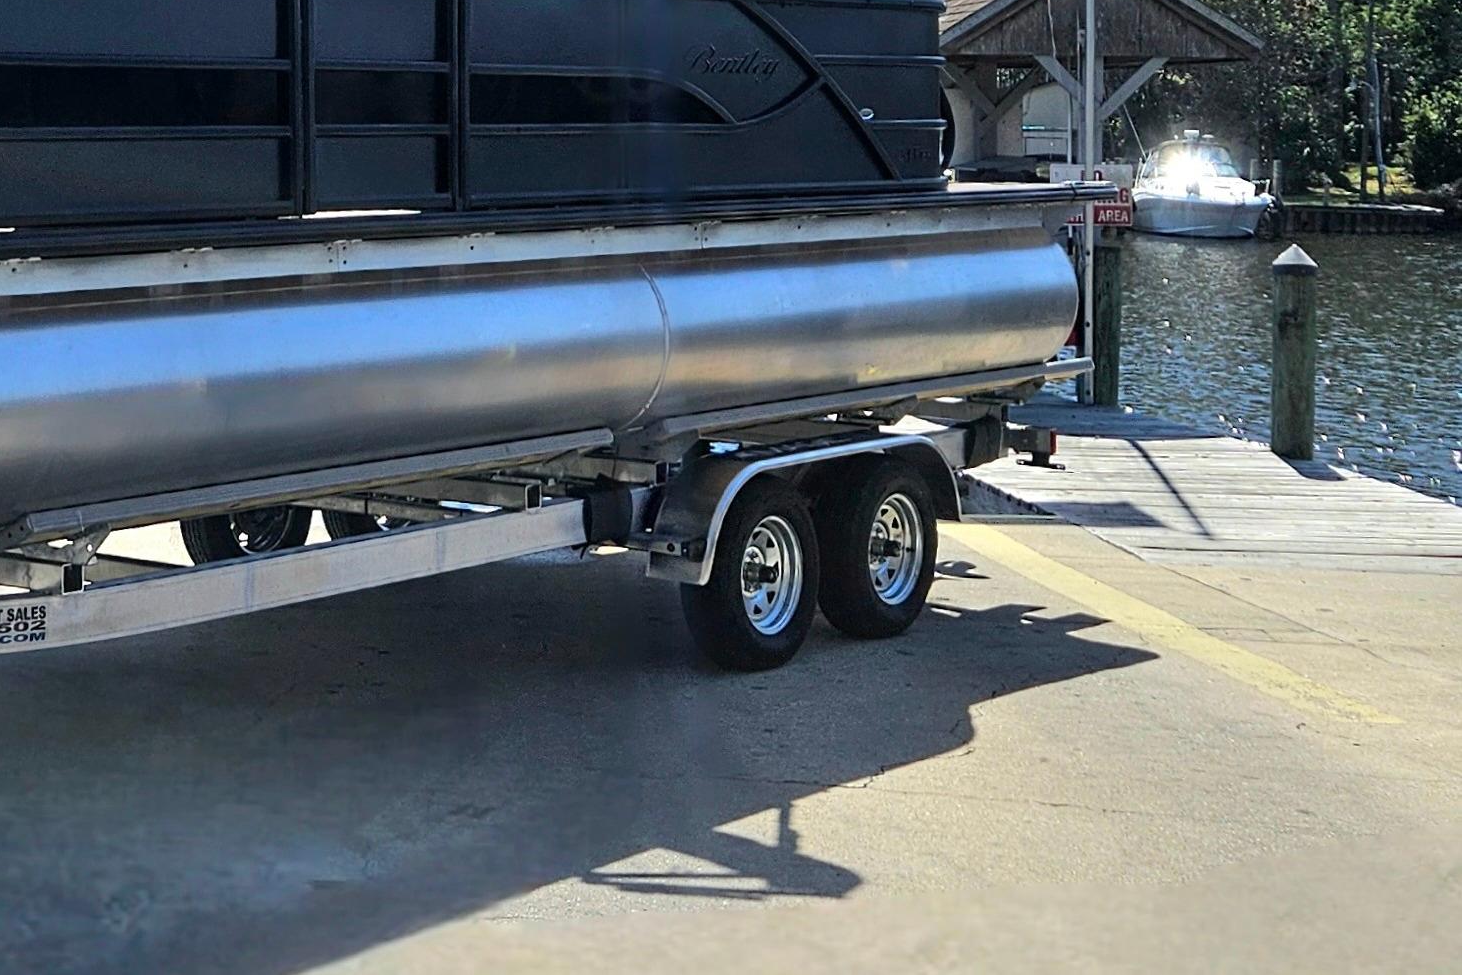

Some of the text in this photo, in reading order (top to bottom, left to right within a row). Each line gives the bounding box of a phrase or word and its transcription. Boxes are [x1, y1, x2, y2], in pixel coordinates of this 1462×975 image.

[683, 42, 779, 83] Bentley
[1098, 209, 1129, 223] AREA
[7, 605, 46, 622] SALES
